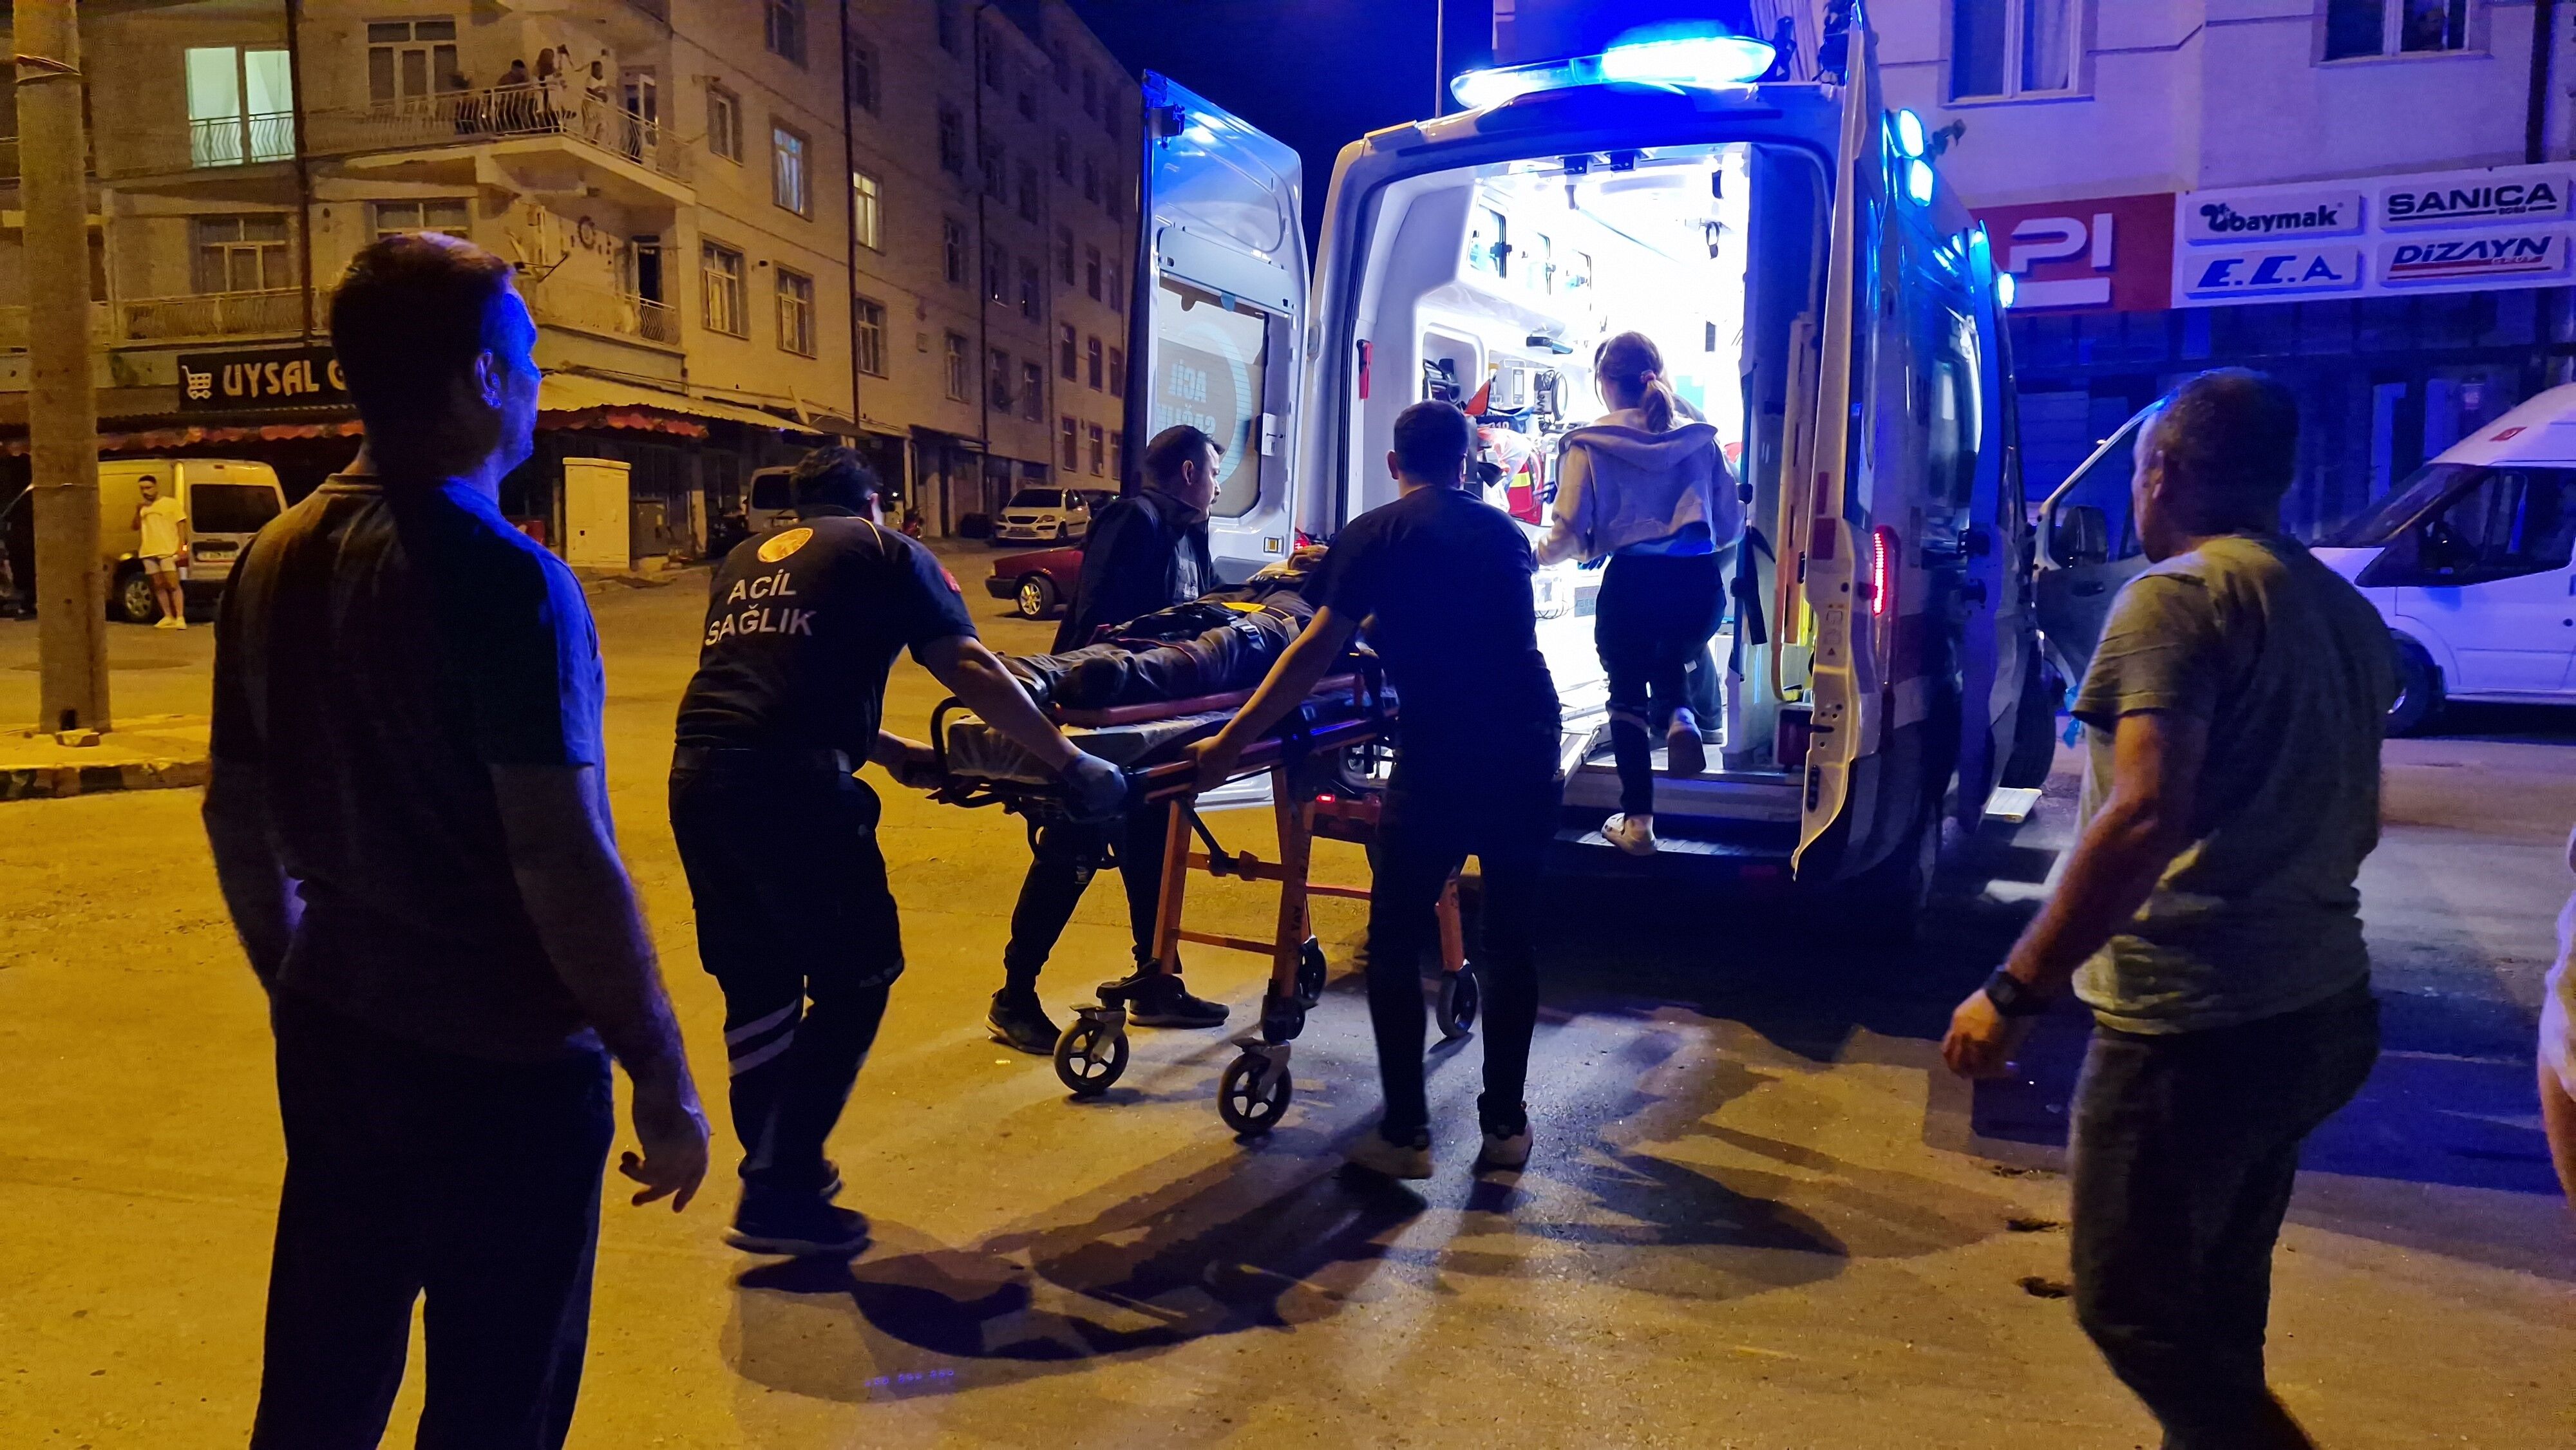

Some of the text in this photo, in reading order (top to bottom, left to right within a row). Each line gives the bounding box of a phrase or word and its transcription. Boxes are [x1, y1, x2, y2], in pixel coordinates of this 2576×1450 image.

[2387, 182, 2557, 214] SANICA
[2228, 205, 2338, 232] baymak
[223, 359, 320, 398] UYSAL
[726, 568, 797, 605] ACİL
[705, 603, 817, 646] SAĞLIK
